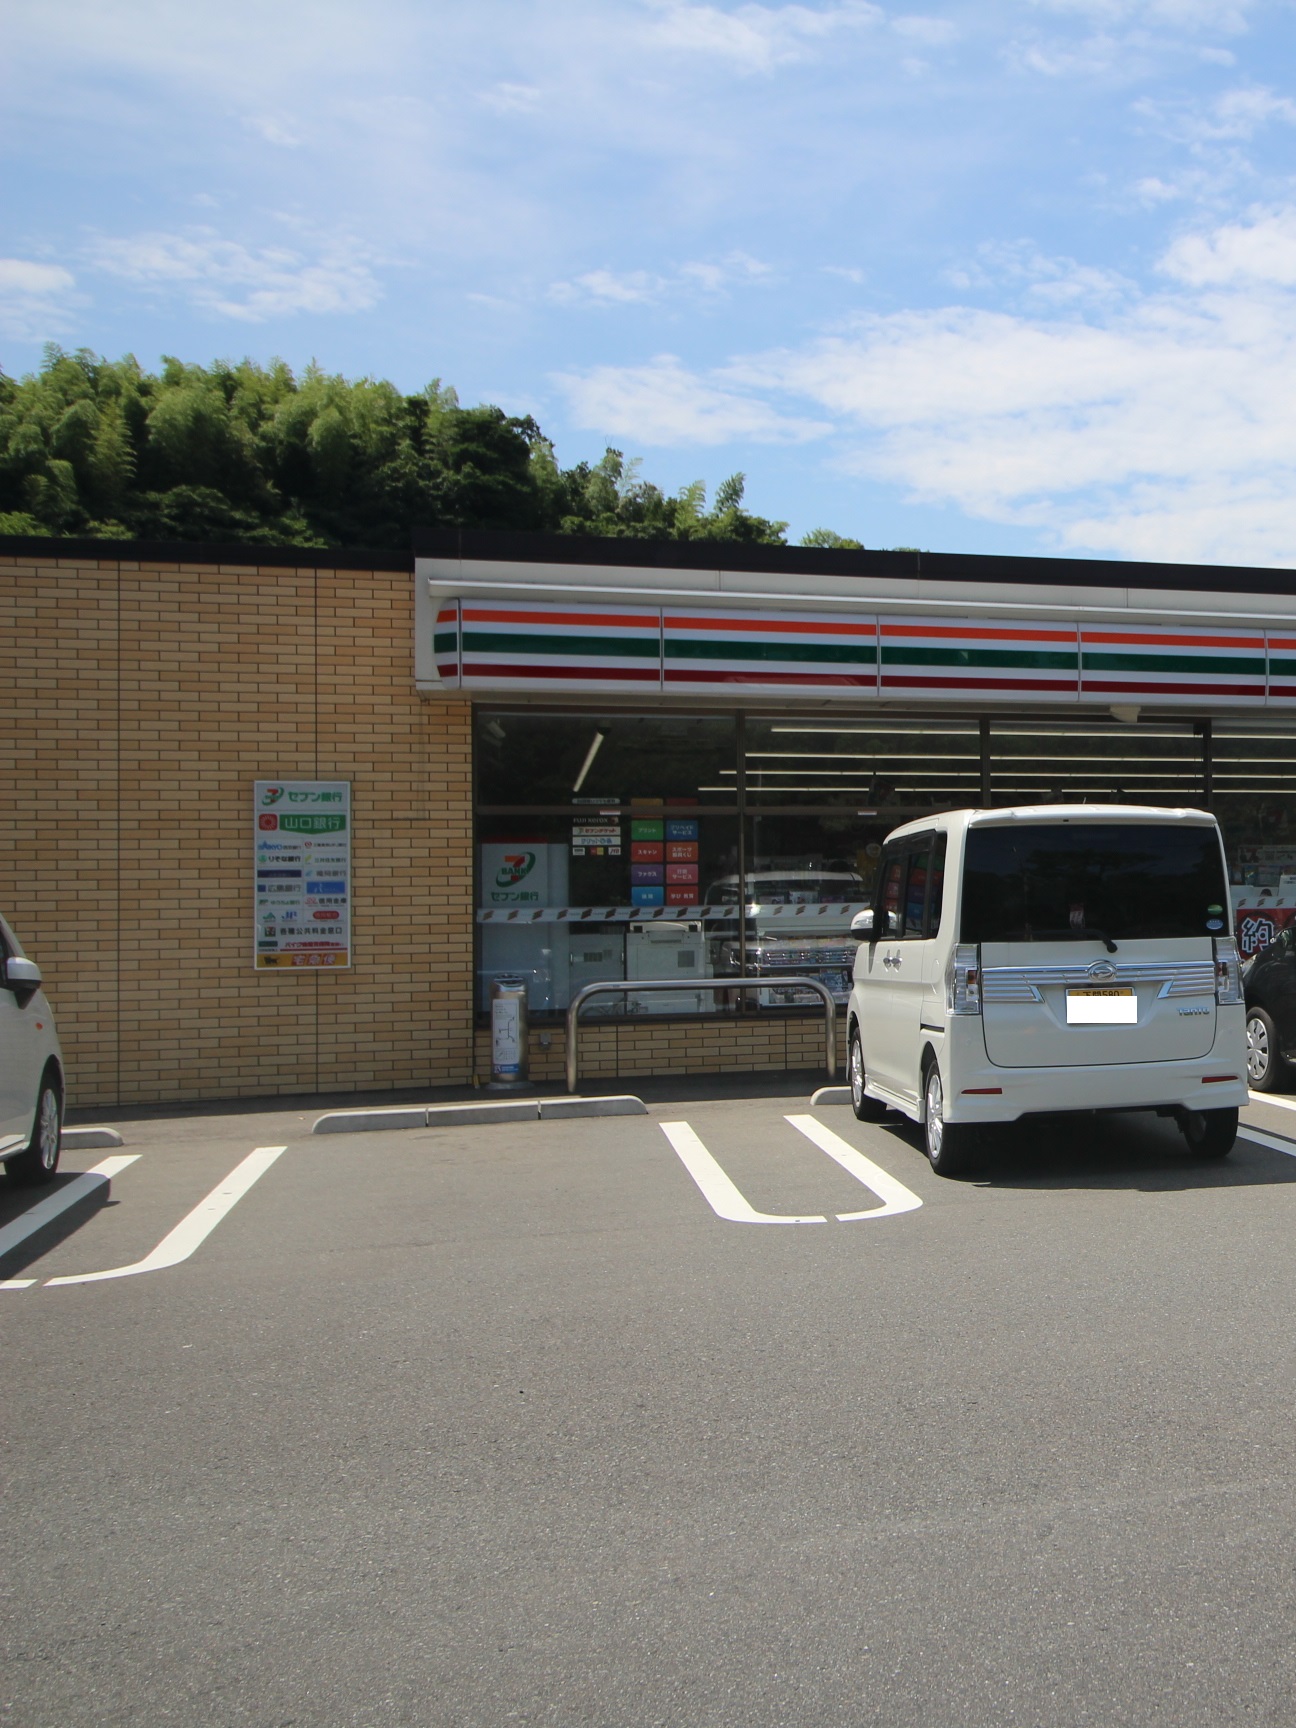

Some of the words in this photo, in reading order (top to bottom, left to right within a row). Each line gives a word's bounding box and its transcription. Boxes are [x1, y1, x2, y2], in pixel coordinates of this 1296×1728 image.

[287, 791, 343, 802] セブン銀行
[285, 816, 340, 829] 山口銀行
[267, 884, 301, 893] 広島銀行
[491, 891, 539, 901] セブン銀行
[281, 926, 342, 935] 各種公共料金窓口
[292, 955, 336, 966] 宅急便
